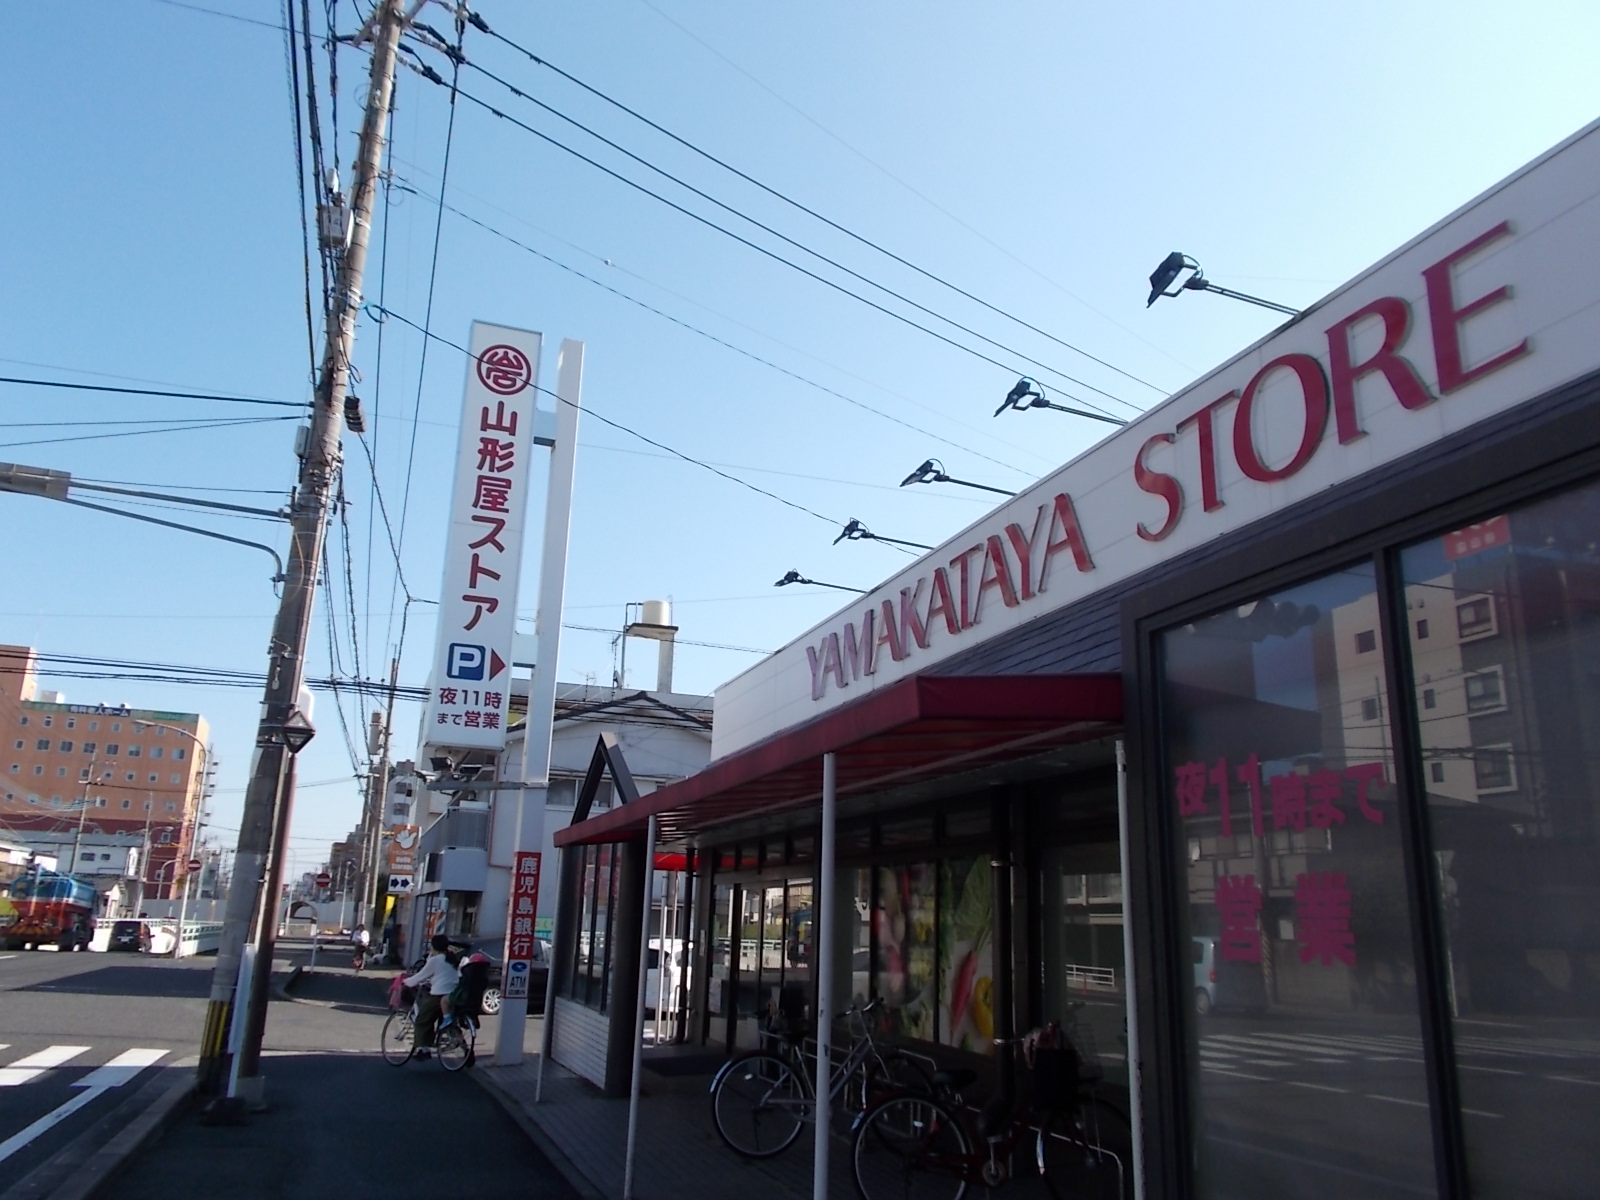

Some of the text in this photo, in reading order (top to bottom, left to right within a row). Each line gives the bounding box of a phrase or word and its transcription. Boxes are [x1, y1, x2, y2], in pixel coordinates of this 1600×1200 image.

[806, 220, 1532, 701] YAMAKATAYA STORE
[461, 400, 518, 632] 山形屋ストア
[439, 687, 503, 710] 夜11時
[451, 645, 482, 677] P
[437, 710, 501, 730] まで営業
[1175, 752, 1386, 838] 夜11時まで
[512, 856, 538, 956] 鹿児島銀行
[1215, 870, 1358, 966] 営業
[509, 976, 527, 989] ATM
